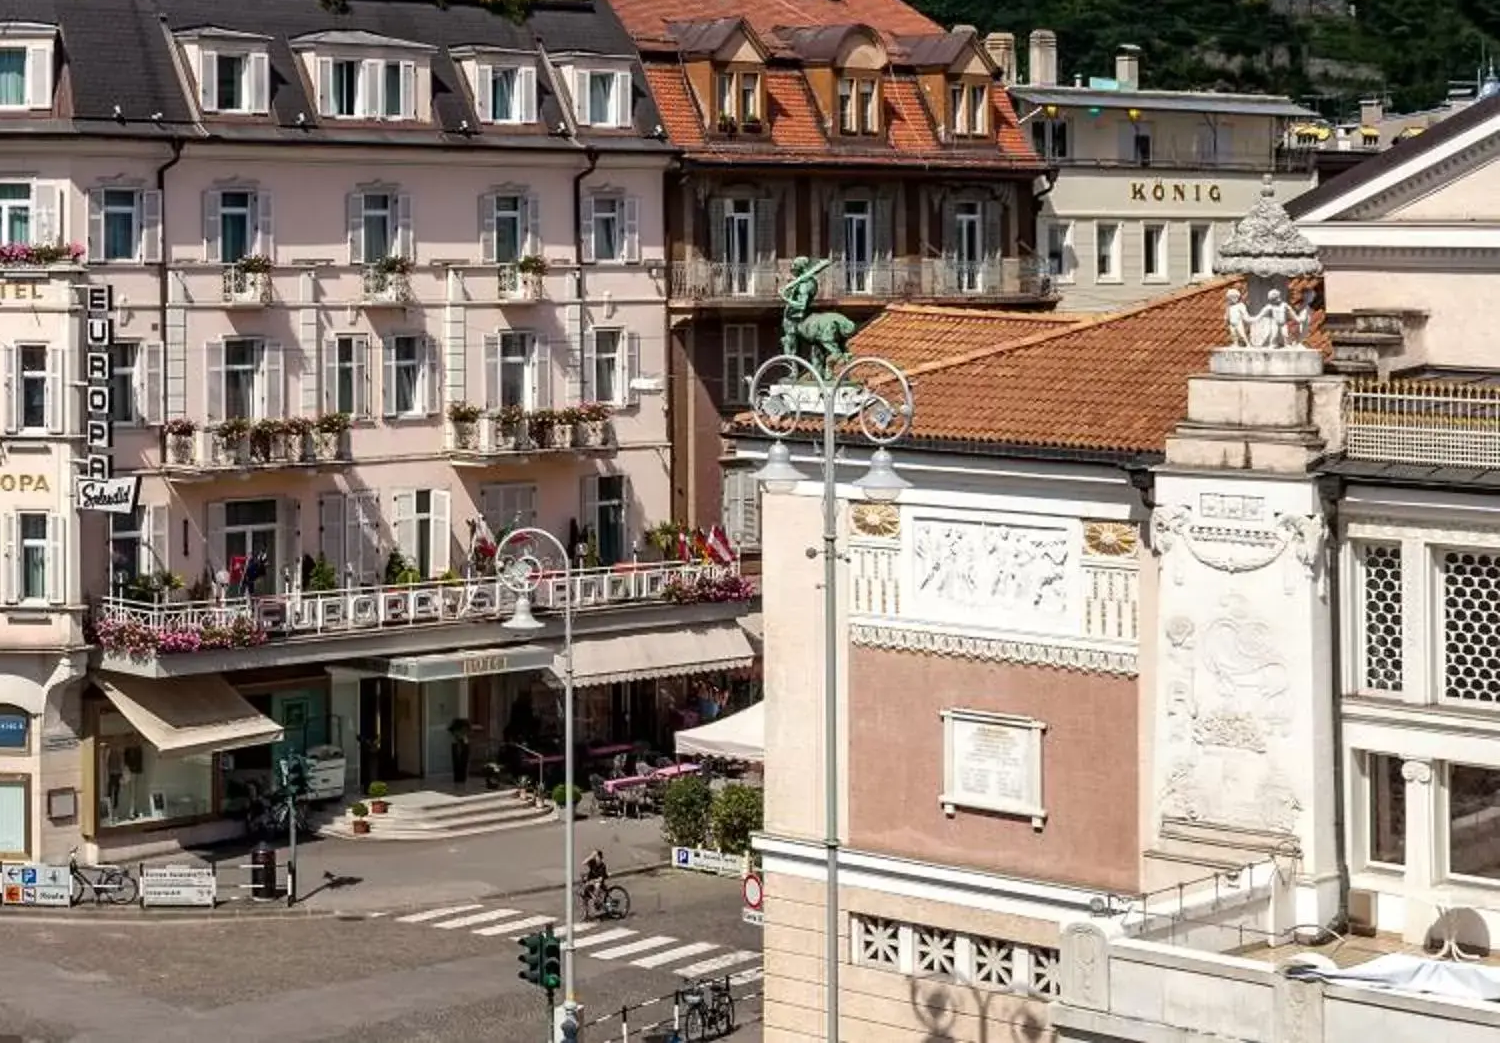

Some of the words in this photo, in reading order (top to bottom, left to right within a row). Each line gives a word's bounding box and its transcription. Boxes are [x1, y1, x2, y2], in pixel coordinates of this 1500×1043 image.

[1131, 176, 1221, 202] KÖNIG
[89, 288, 107, 478] EUROPA
[82, 481, 131, 507] Splendid
